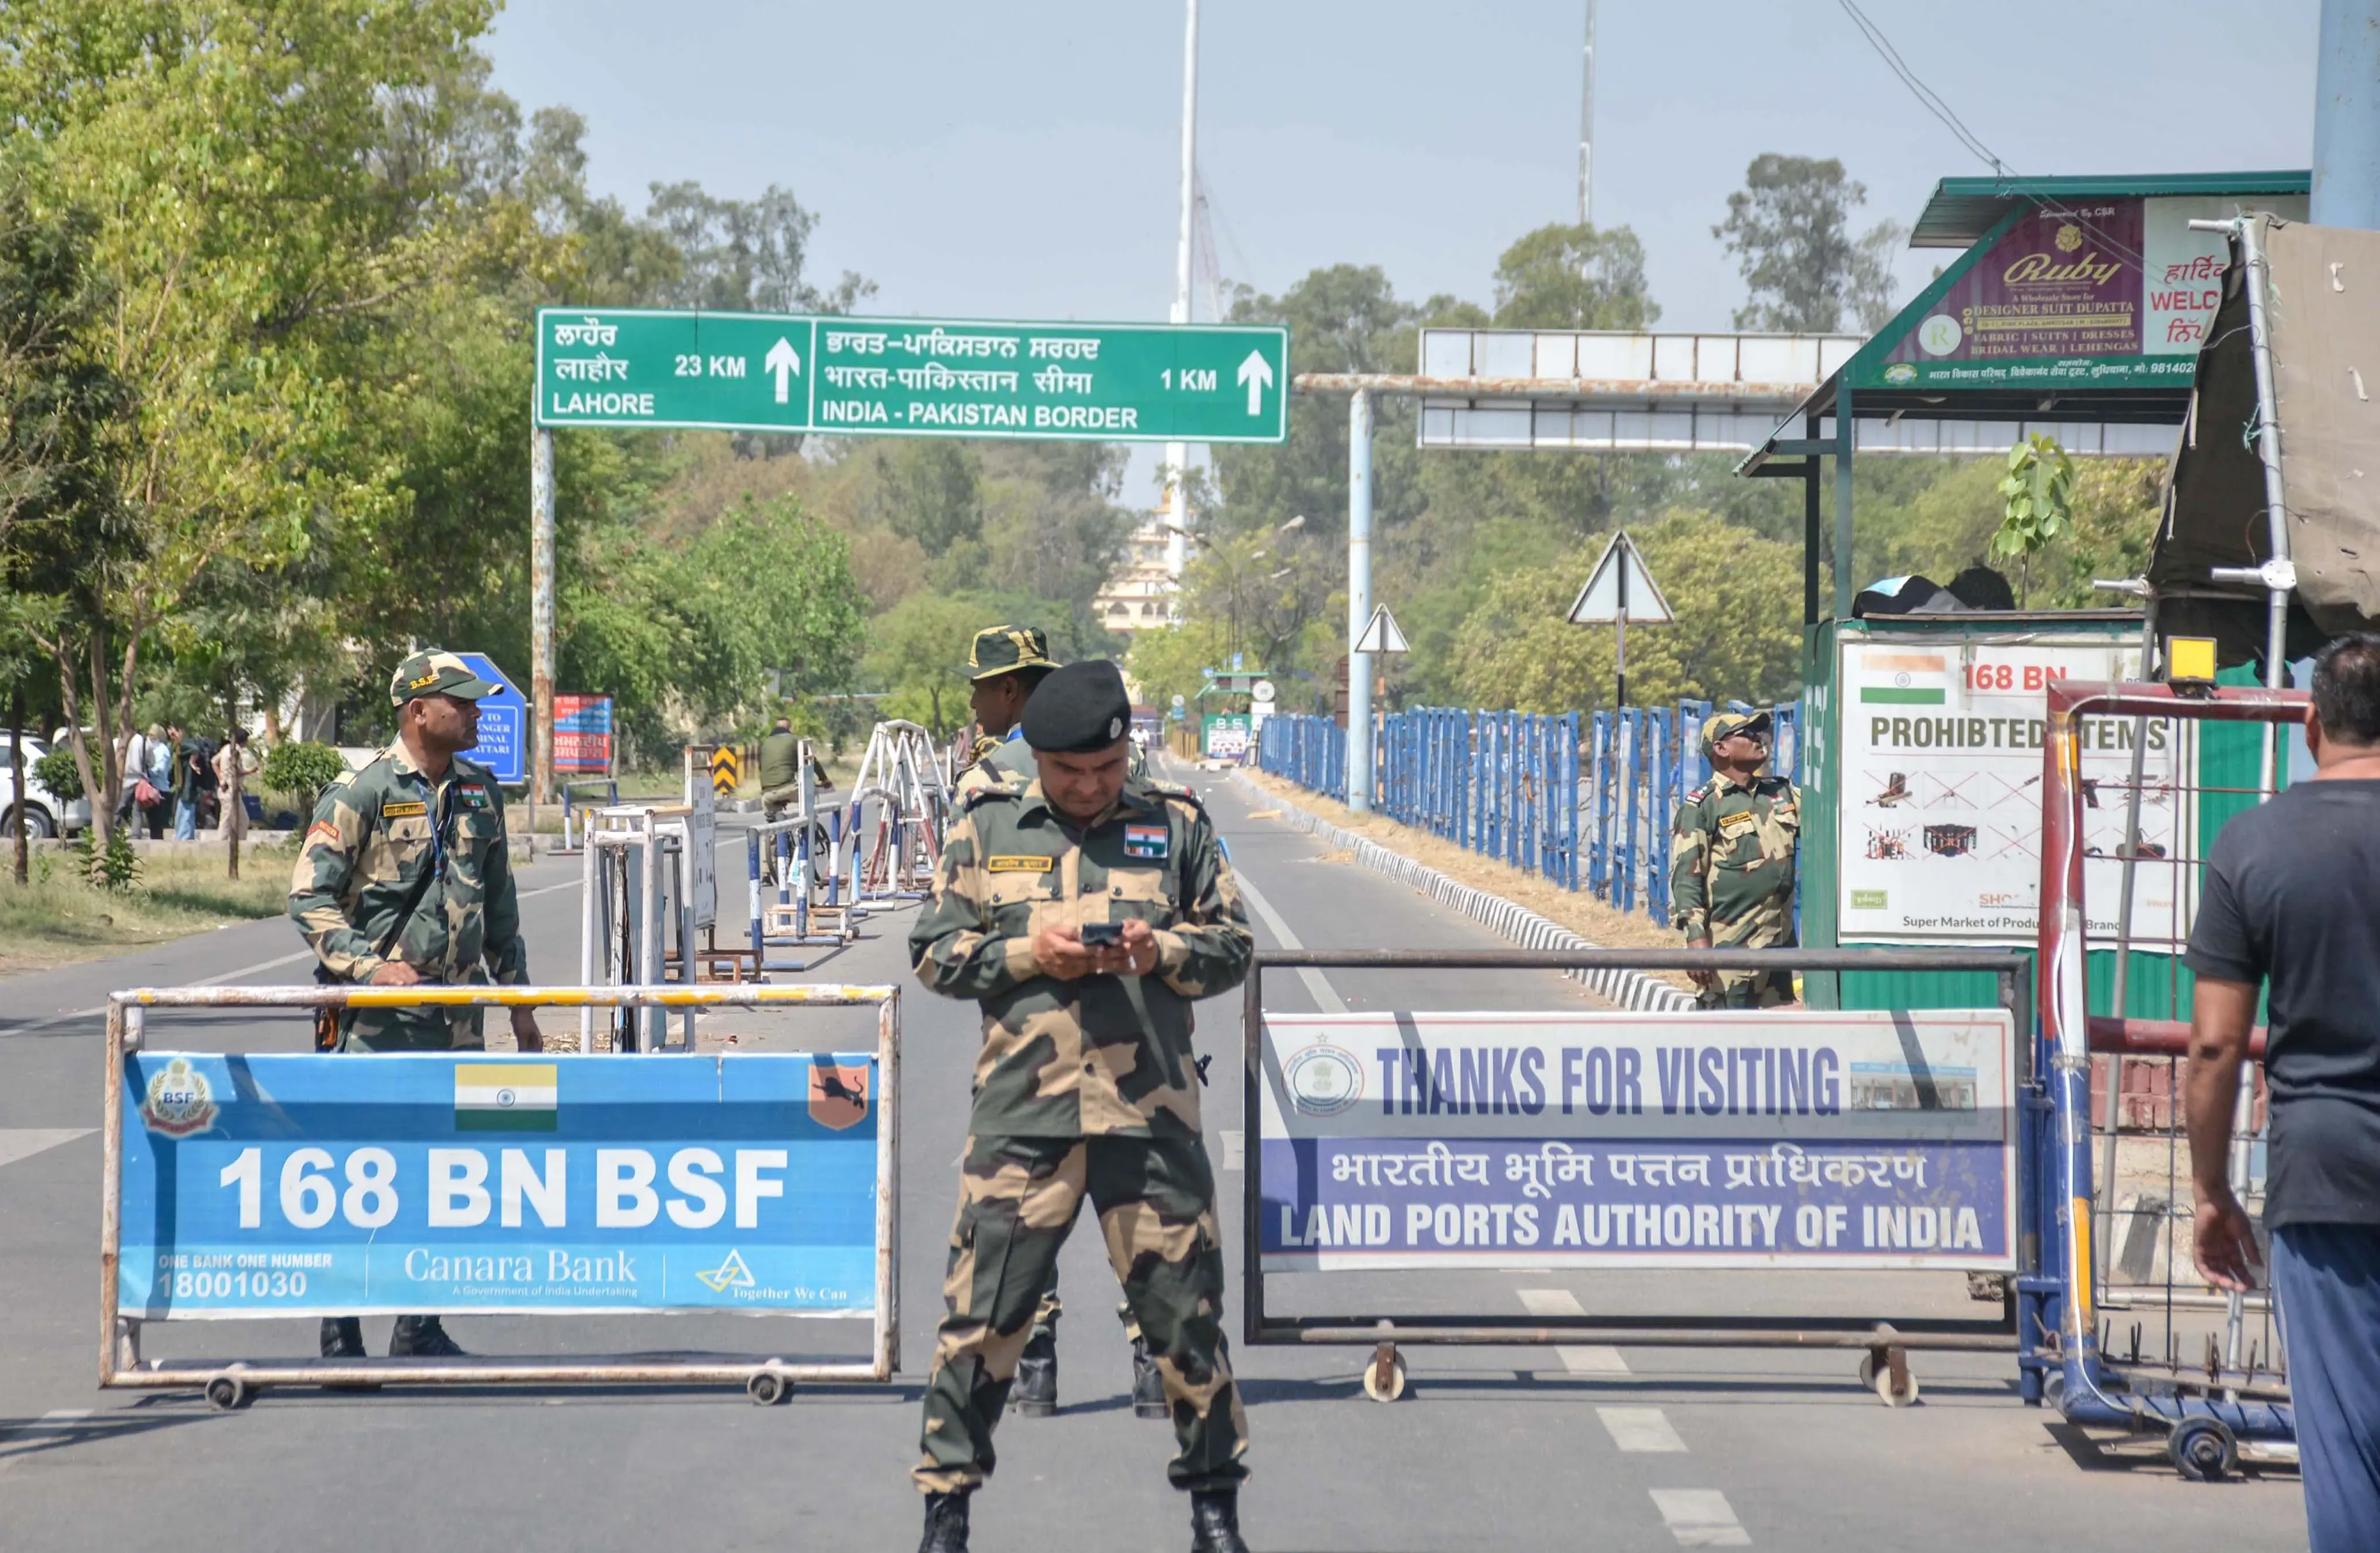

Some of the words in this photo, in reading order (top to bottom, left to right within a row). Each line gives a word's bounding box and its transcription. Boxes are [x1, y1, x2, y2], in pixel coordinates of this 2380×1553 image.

[2004, 252, 2122, 285] Ruby
[1973, 304, 2039, 316] DESIGNER
[2042, 303, 2074, 314] SUIT
[2076, 302, 2135, 313] DUPATTA
[2151, 291, 2221, 311] WELC
[554, 315, 618, 346] ਲਾਹੌਰ
[1930, 324, 1949, 345] R
[1973, 333, 2020, 343] FABRIC
[2031, 331, 2069, 341] SUITS
[2081, 329, 2136, 340] DRESSES
[1971, 345, 2017, 356] BRIDAL
[2020, 344, 2058, 354] WEAR
[2070, 342, 2139, 353] LEHENGAS
[554, 351, 628, 382] लाहौर
[674, 354, 702, 376] 23
[709, 356, 746, 377] KM
[1928, 370, 1950, 380] भारत
[1951, 368, 1978, 379] विकास
[2050, 365, 2067, 377] सेवा
[2150, 362, 2197, 374] 981402
[824, 361, 1019, 393] भारत-पाकिस्तान
[1032, 364, 1093, 394] सीमा
[1161, 368, 1171, 391] 1
[1180, 369, 1217, 391] KM
[553, 393, 654, 415] LAHORE
[823, 400, 888, 423] INDIA
[909, 403, 1027, 426] PAKISTAN
[1035, 405, 1138, 429] BORDER
[1962, 664, 2013, 690] 168
[2024, 665, 2067, 690] BN
[477, 724, 511, 733] ENGER
[487, 713, 502, 722] TO
[476, 734, 508, 743] MINAL
[1871, 716, 2045, 749] PROHIBTED
[2081, 719, 2166, 751] TEMS
[1978, 894, 2012, 905] SHO
[1903, 915, 1939, 928] Super
[1941, 917, 1985, 929] Market
[1988, 917, 2001, 928] of
[2003, 918, 2040, 929] Produ
[1376, 1046, 1546, 1115] THANKS
[1561, 1046, 1643, 1115] FOR
[1657, 1046, 1839, 1117] VISITING
[163, 1092, 194, 1104] BSF
[1332, 1141, 1491, 1187] भारतीय
[1505, 1141, 1595, 1199] भूमि
[1608, 1154, 1711, 1187] पत्तन
[1724, 1142, 1928, 1190] प्राधिकरण
[220, 1147, 399, 1229] 168
[428, 1149, 566, 1227] BN
[596, 1147, 788, 1229] BSF
[1280, 1204, 1391, 1246] LAND
[1407, 1204, 1540, 1247] PORTS
[1553, 1204, 1783, 1247] AUTHORITY
[1795, 1205, 1848, 1249] OF
[1863, 1206, 1984, 1250] INDIA
[159, 1254, 188, 1268] ONE
[193, 1254, 233, 1268] BANK
[237, 1254, 267, 1268] ONE
[271, 1253, 333, 1268] NUMBER
[404, 1248, 534, 1282] Canara
[547, 1249, 638, 1282] Bank
[158, 1270, 307, 1299] 18001030
[452, 1286, 461, 1296] A
[463, 1285, 529, 1297] Government
[531, 1285, 543, 1296] of
[545, 1286, 571, 1297] India
[573, 1286, 638, 1299] Undertaking
[731, 1287, 790, 1300] Together
[794, 1287, 816, 1300] We
[819, 1288, 847, 1300] Can
